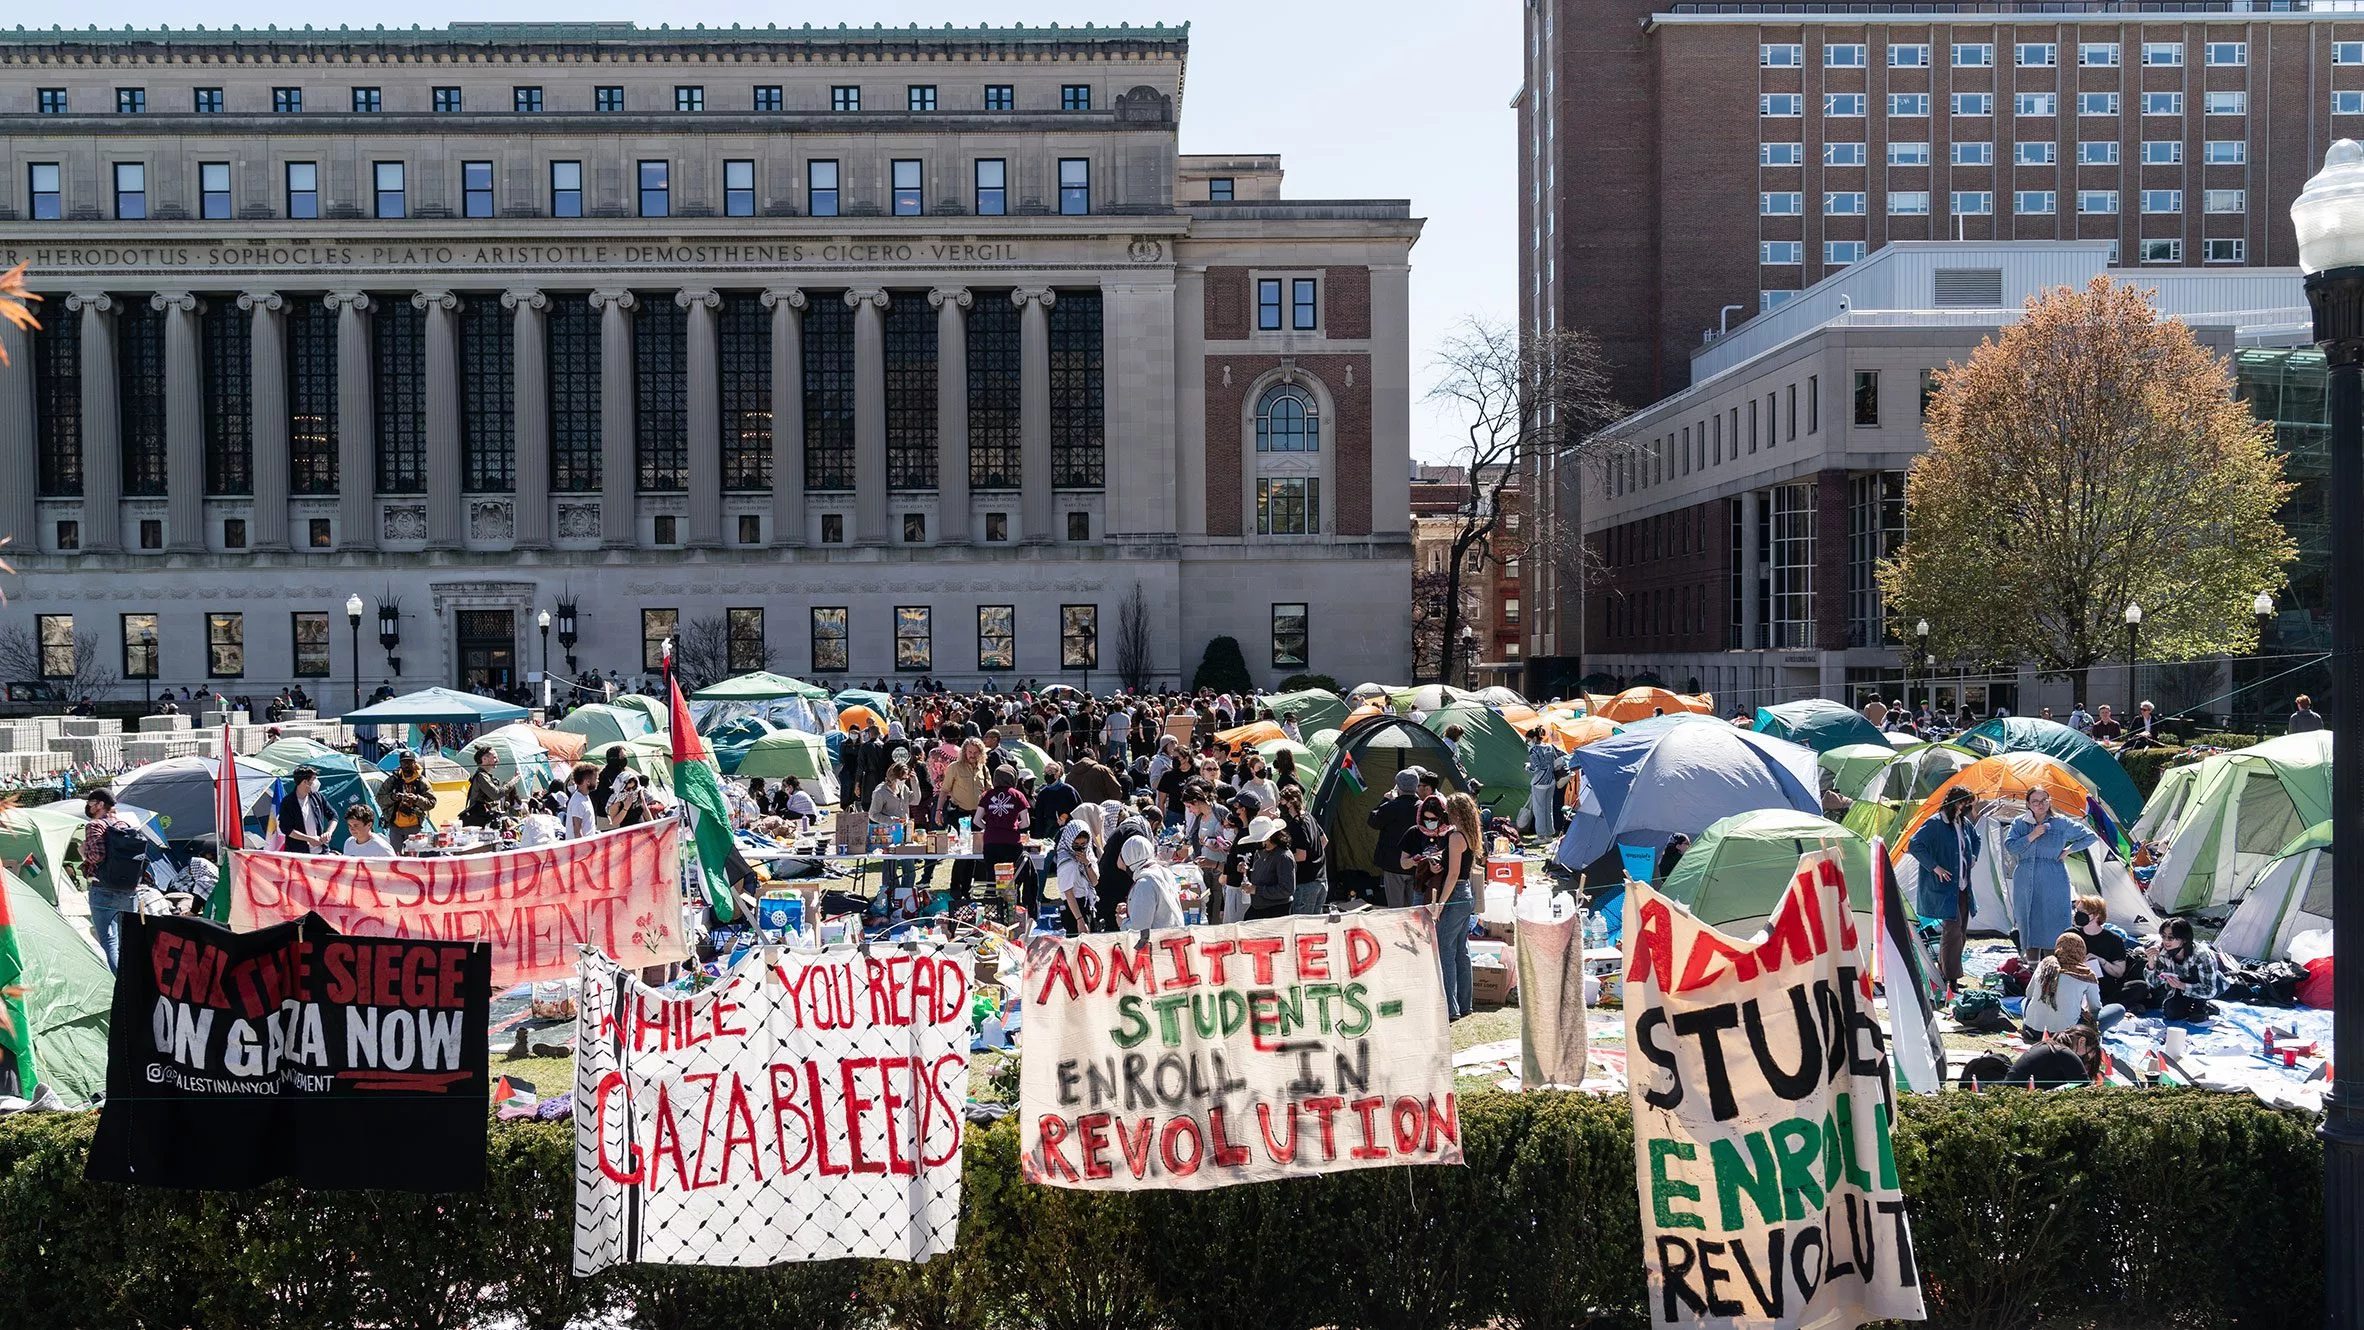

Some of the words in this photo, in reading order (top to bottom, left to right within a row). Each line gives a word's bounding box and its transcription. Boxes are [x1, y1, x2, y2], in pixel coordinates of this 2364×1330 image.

[37, 248, 188, 266] HERODOTUS
[208, 247, 352, 265] SOPHOCLES
[373, 247, 453, 264] PLATO
[474, 246, 607, 264] ARISTOTLE
[625, 245, 804, 263] DEMOSTHENES
[821, 245, 912, 262] CICERO
[930, 244, 1018, 261] VERGIL
[243, 852, 392, 911] GAZA
[230, 940, 315, 1020] THE
[323, 942, 468, 1008] SIEGE
[598, 978, 747, 1053] WHILE
[774, 963, 856, 1030] YOU
[865, 955, 967, 1027] READ
[1036, 927, 1381, 1006] ADMITTED
[152, 995, 215, 1069] ON
[224, 999, 329, 1077] GAZA
[346, 1005, 464, 1071] NOW
[1057, 1032, 1246, 1111] ENROLL
[1274, 1037, 1370, 1094] IN
[596, 1070, 764, 1193] GAZA
[768, 1053, 965, 1177] BLEEDS
[1038, 1092, 1458, 1183] REVOLUTION
